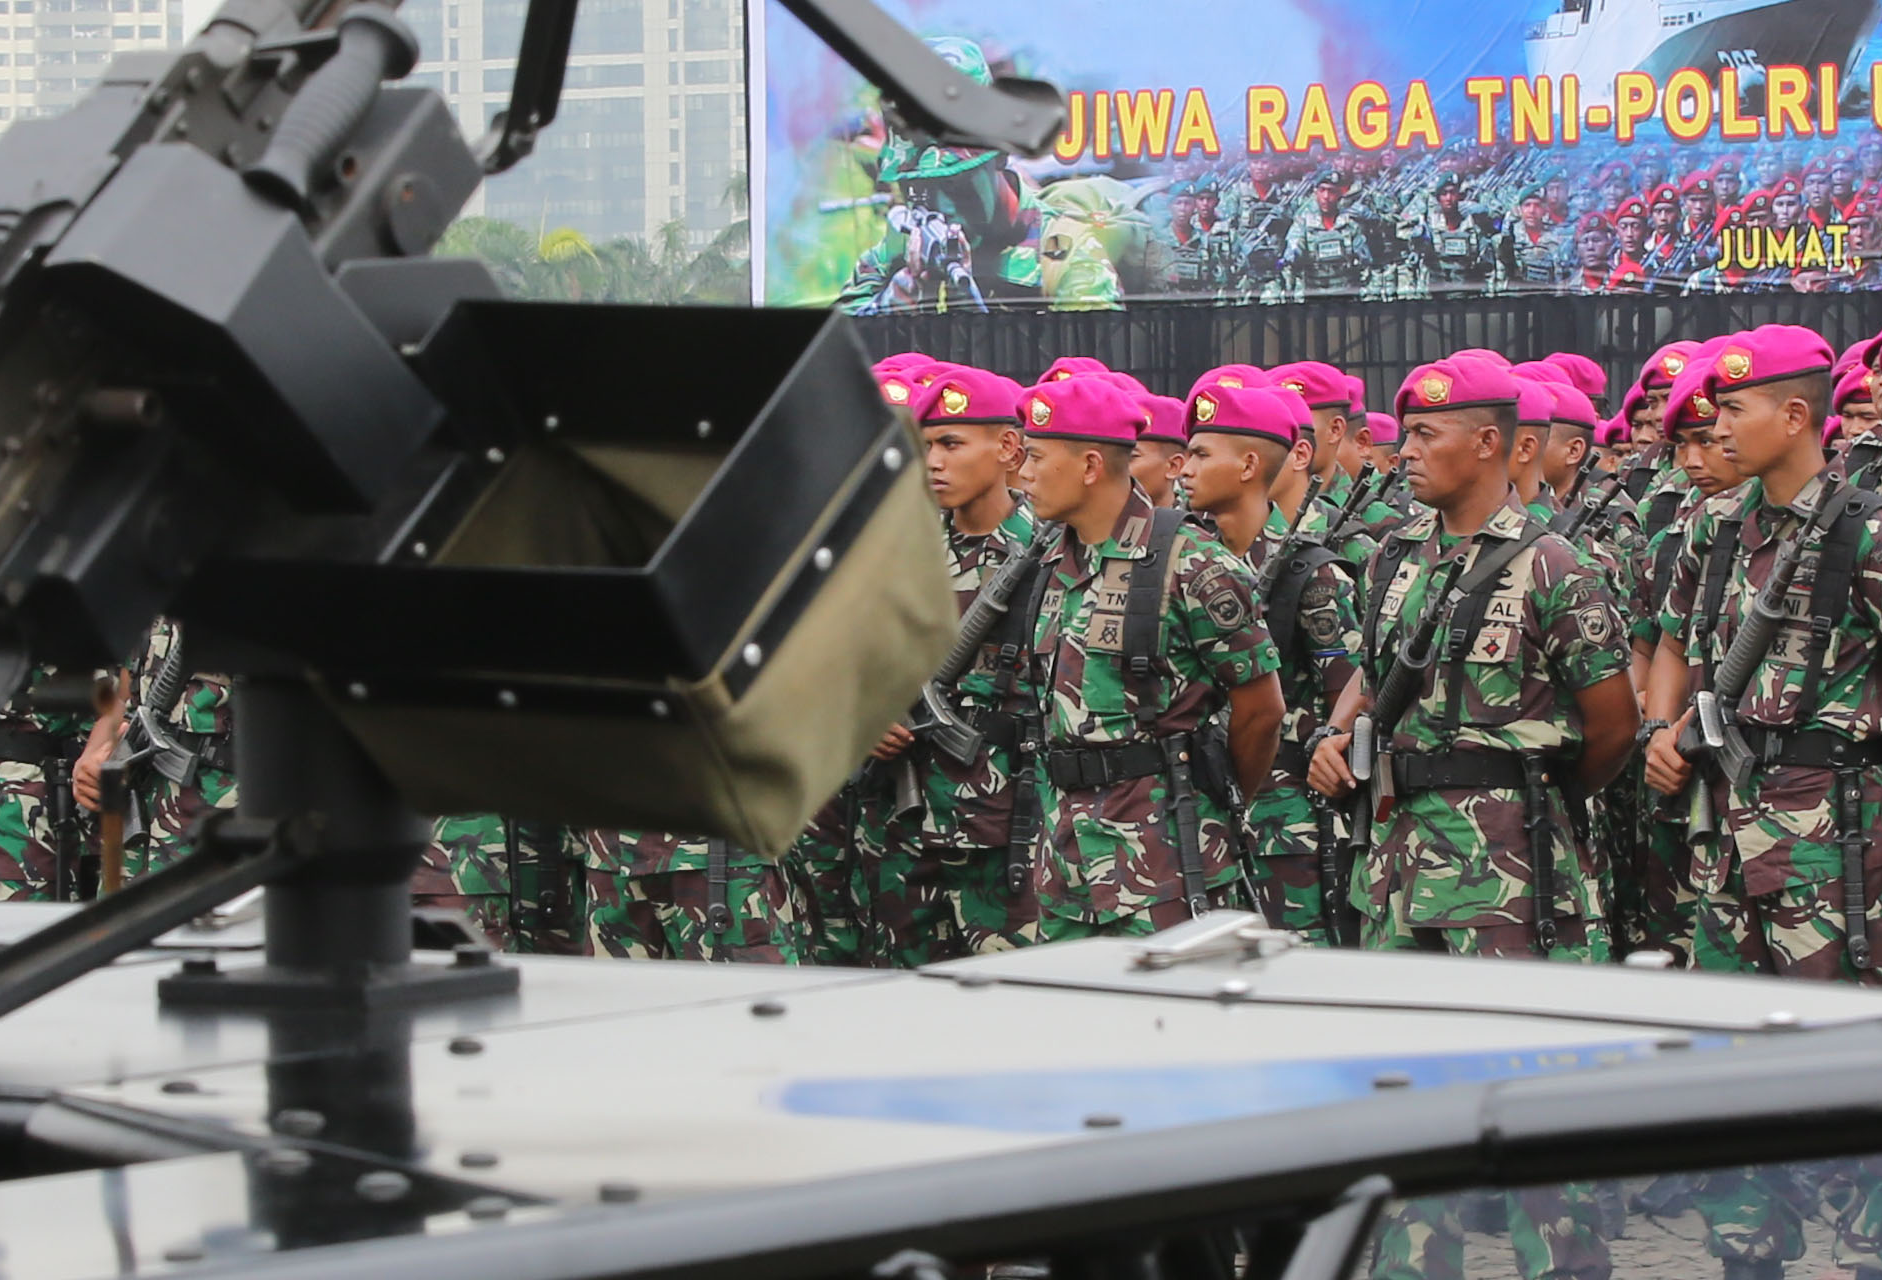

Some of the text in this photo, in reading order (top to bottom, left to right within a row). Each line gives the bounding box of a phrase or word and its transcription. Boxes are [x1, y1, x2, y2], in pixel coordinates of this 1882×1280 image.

[1053, 88, 1221, 160] JIWA
[1247, 80, 1442, 153] RAGA
[1465, 64, 1837, 145] TNI-POLRI
[1715, 223, 1862, 271] JUMAT,
[1491, 601, 1517, 618] AL
